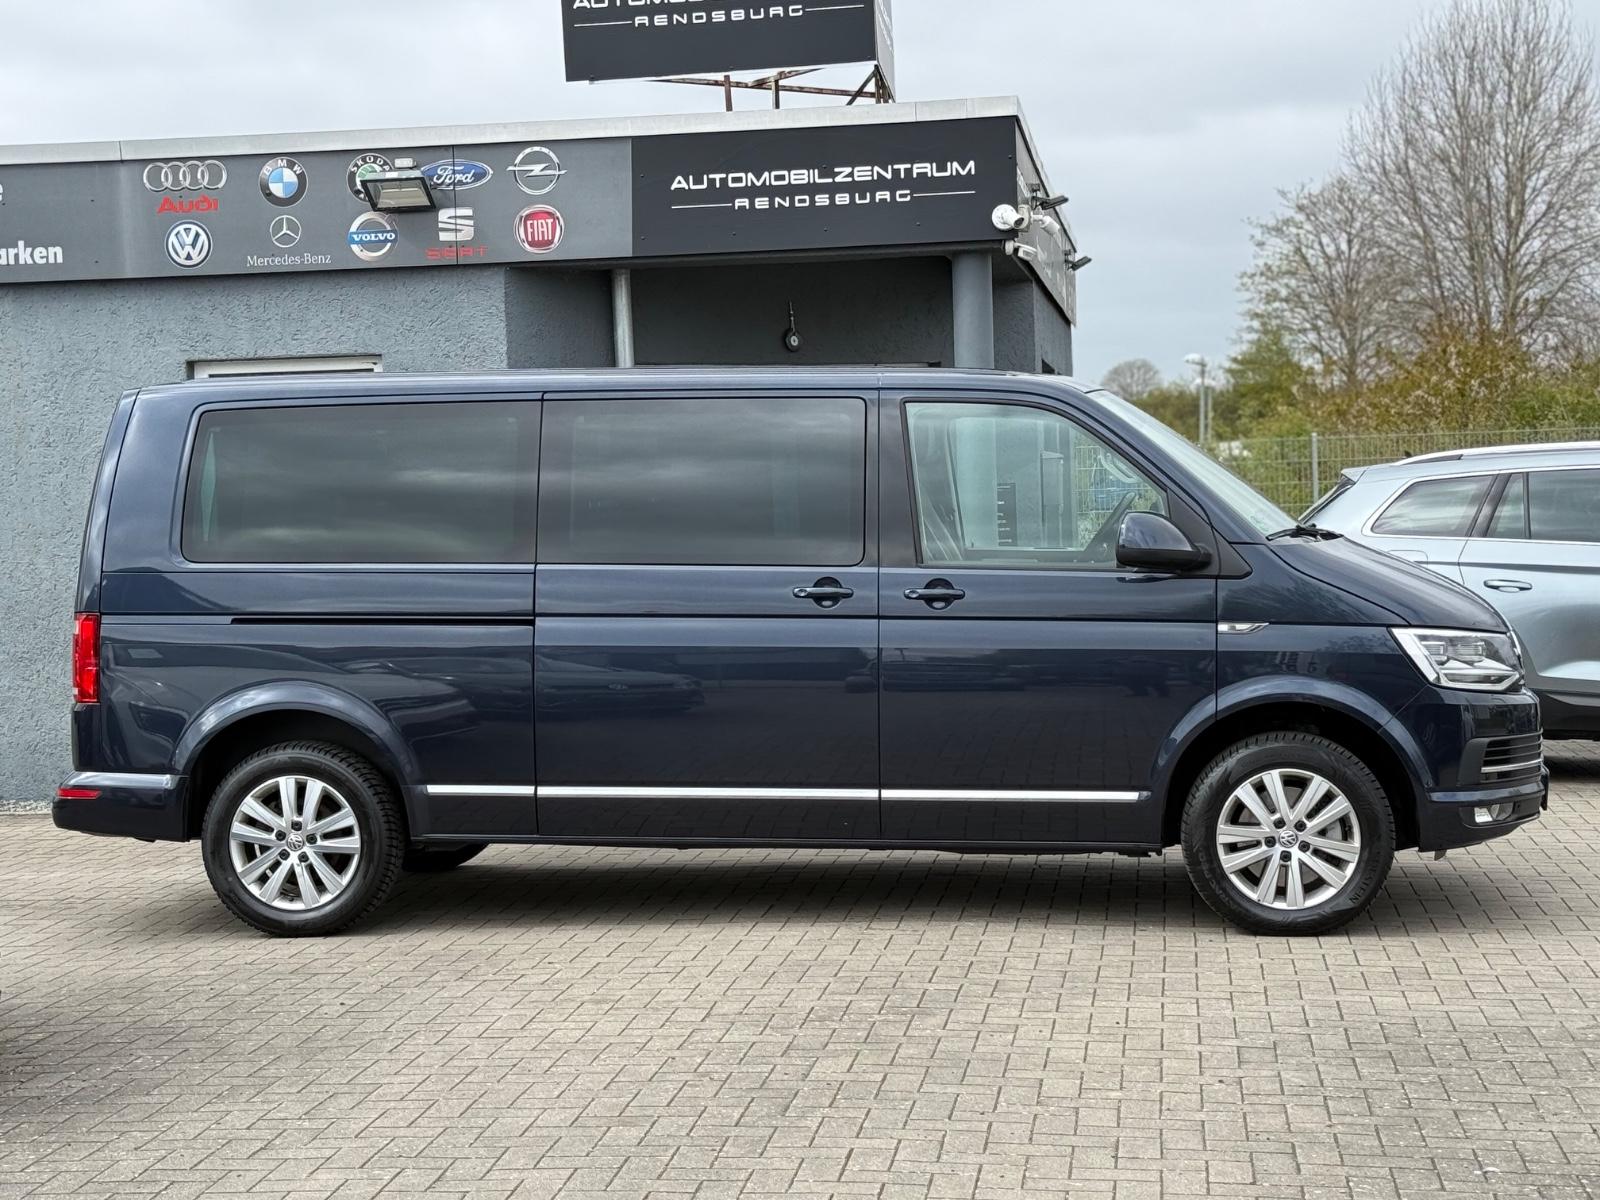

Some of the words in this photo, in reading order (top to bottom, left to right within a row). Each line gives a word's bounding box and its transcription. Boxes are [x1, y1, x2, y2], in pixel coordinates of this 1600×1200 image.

[634, 4, 803, 27] RENDSBURG
[264, 159, 304, 175] BMW
[433, 166, 476, 185] Ford
[670, 160, 976, 191] AUTOMOBILZENTRUM
[734, 189, 911, 210] RENDSBURG
[352, 232, 396, 243] VOLVO
[527, 219, 555, 242] FIAT
[246, 252, 332, 268] Mercedes-Benz
